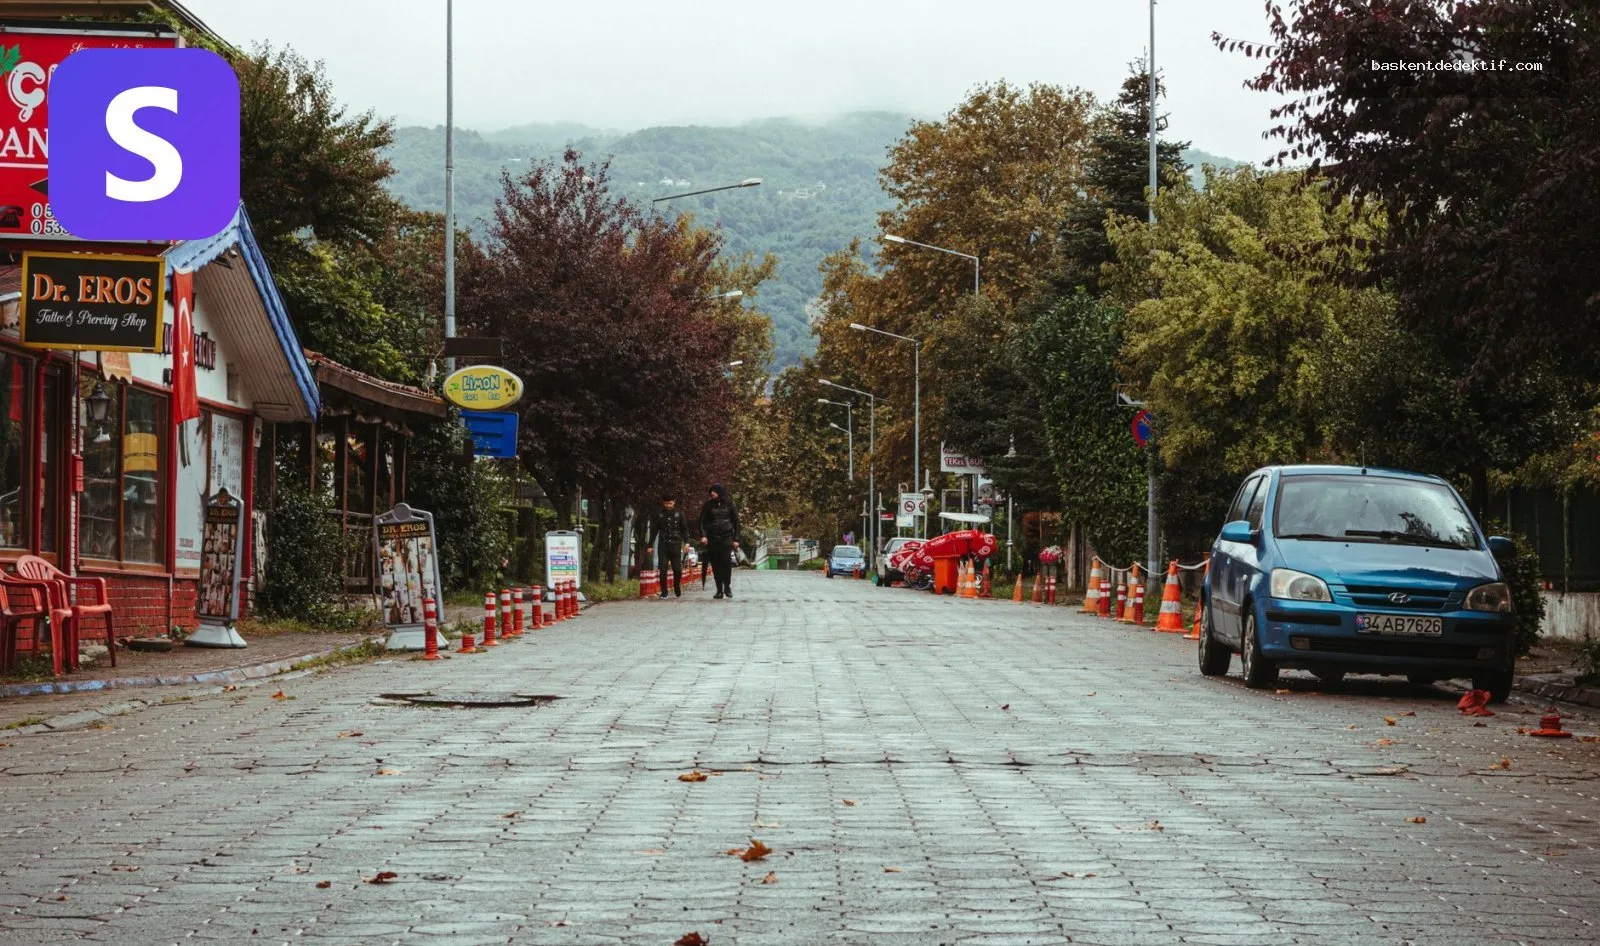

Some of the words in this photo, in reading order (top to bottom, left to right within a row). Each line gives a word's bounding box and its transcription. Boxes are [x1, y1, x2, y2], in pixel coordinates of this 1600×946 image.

[32, 273, 70, 302] Dr.
[77, 275, 153, 305] EROS
[76, 310, 118, 331] Piercing
[121, 312, 147, 332] Shop
[945, 457, 966, 466] TEKEL
[400, 523, 426, 532] EROS
[1365, 616, 1380, 631] 34
